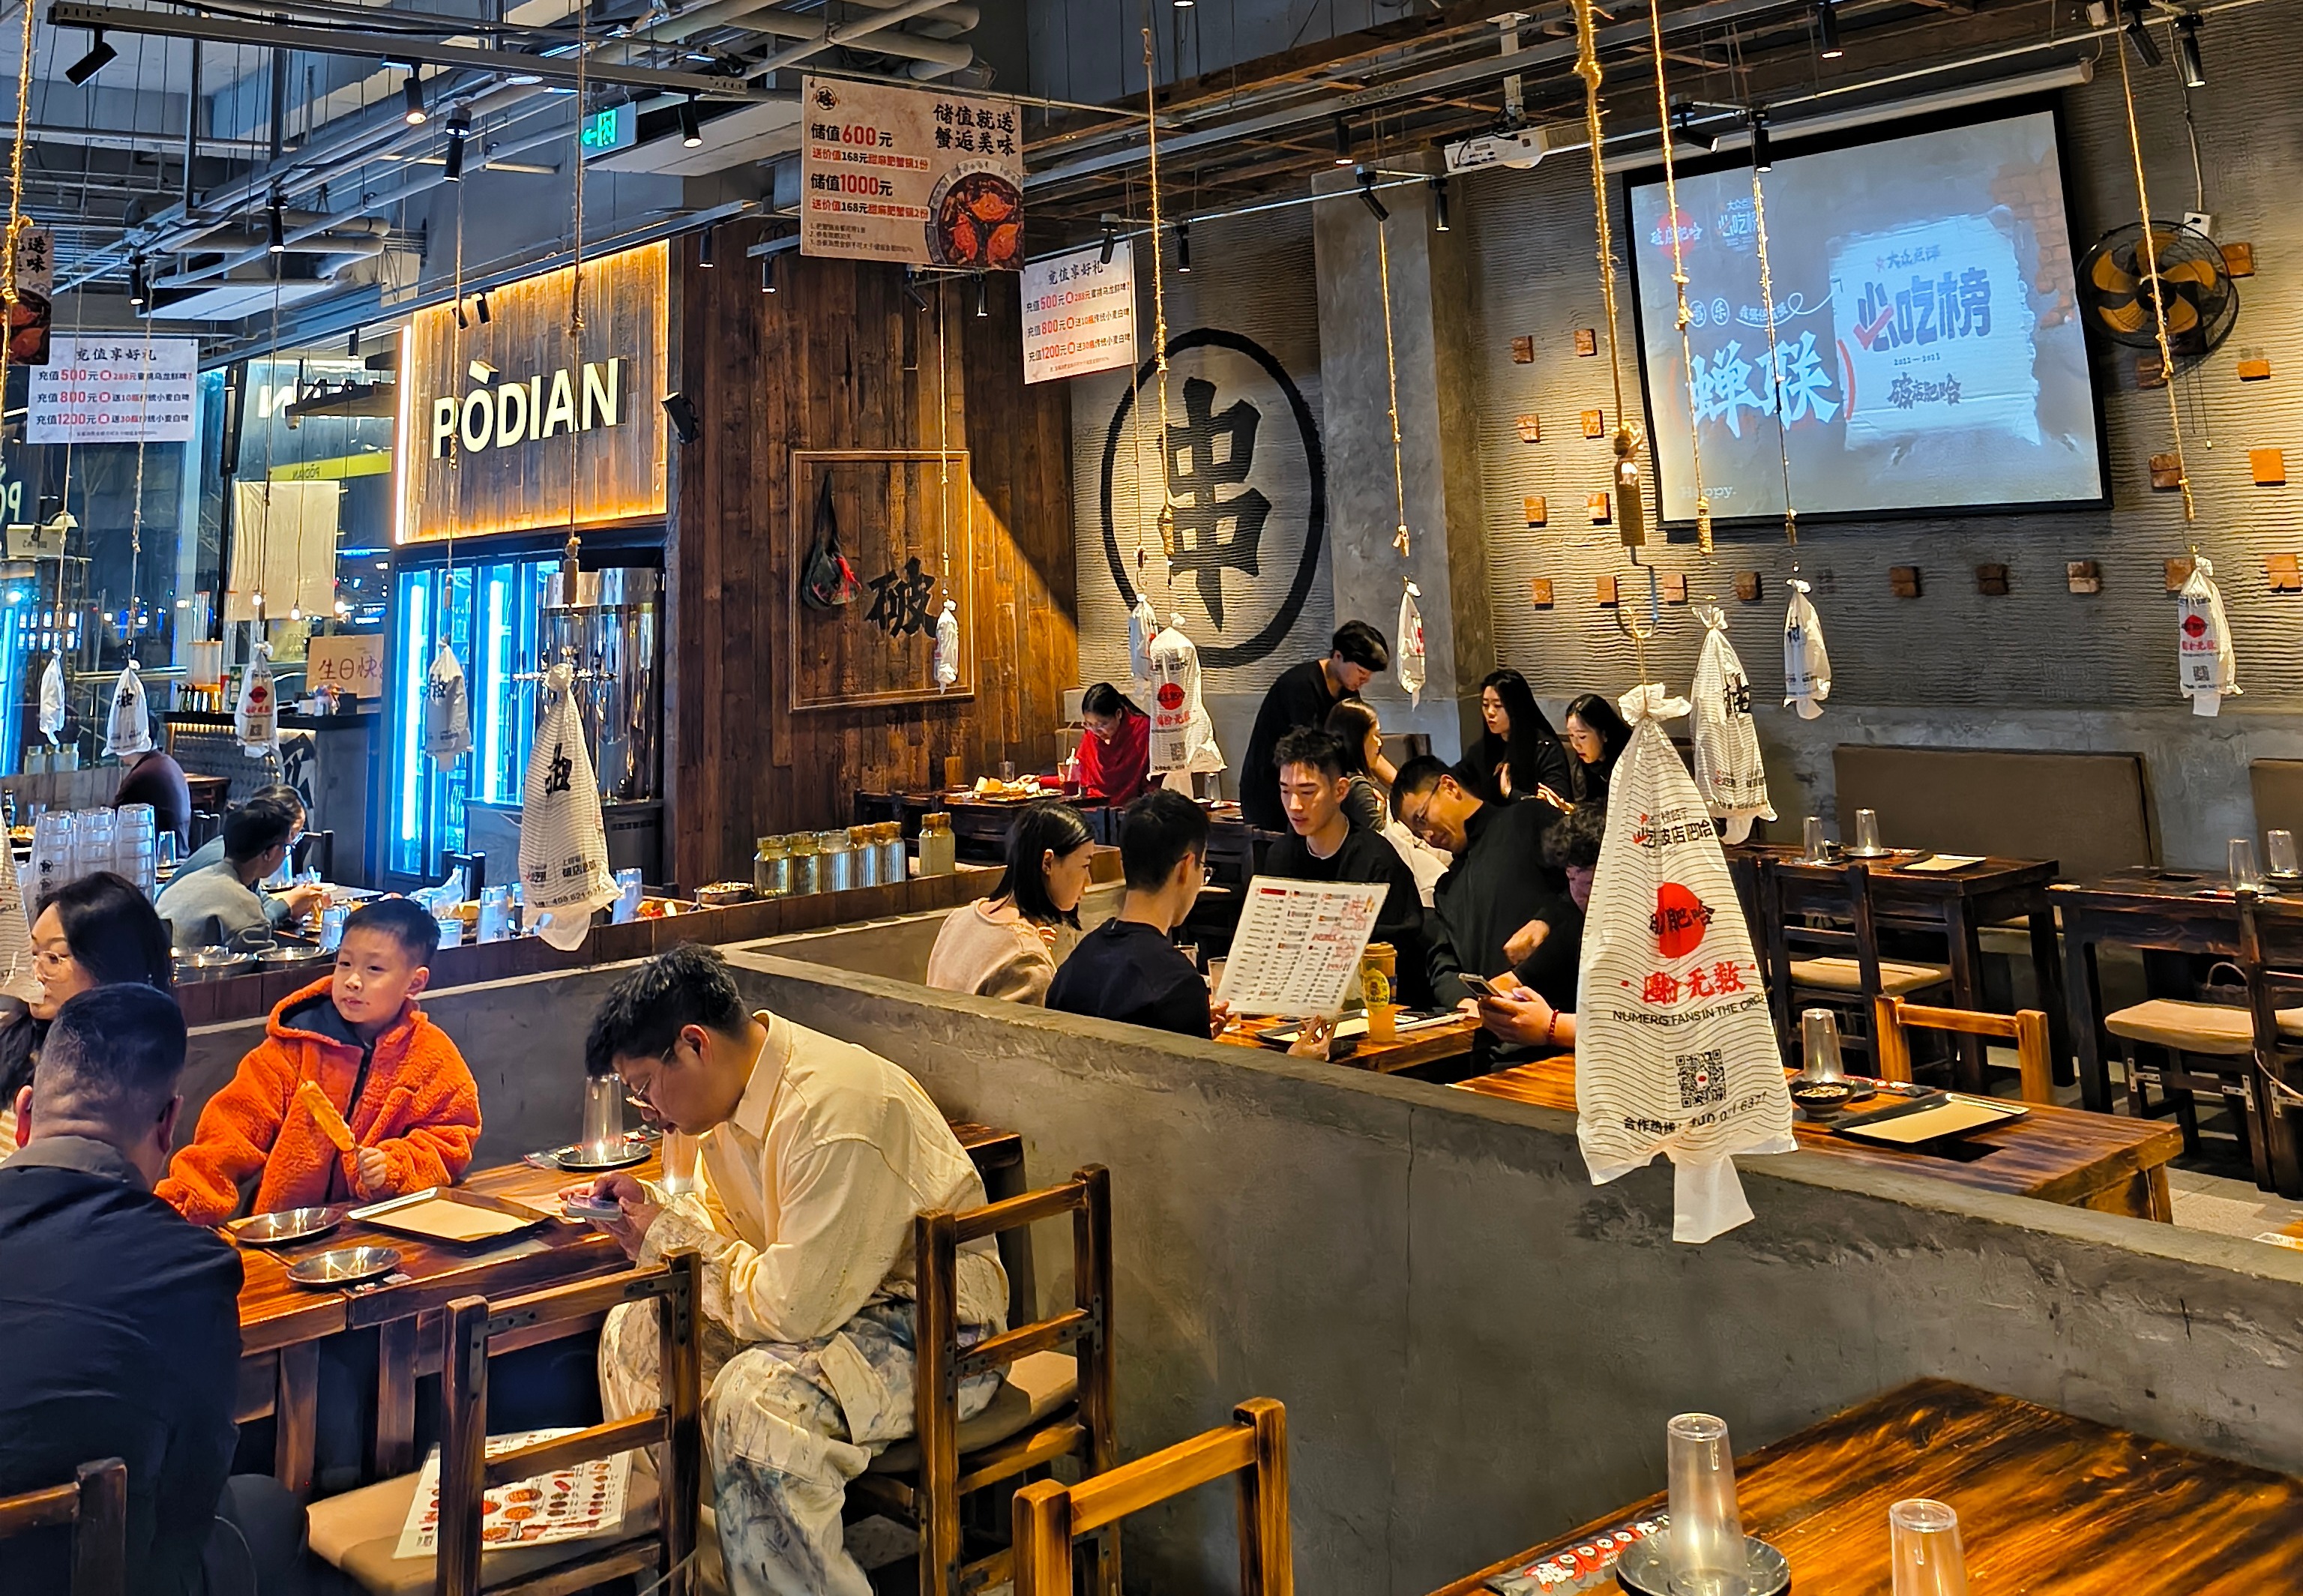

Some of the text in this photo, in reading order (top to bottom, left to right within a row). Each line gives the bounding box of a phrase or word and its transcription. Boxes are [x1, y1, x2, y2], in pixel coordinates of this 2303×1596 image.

[933, 103, 1015, 133] 储值就送
[811, 123, 893, 148] 储值600元
[810, 172, 893, 196] 储值1000元
[1858, 266, 1991, 352] 必吃榜
[1691, 331, 1838, 439] 蝉联
[1157, 376, 1272, 633] 串
[864, 555, 937, 638] 破
[319, 655, 383, 681] 生日快
[1671, 1011, 1701, 1025] FANS
[1701, 1008, 1715, 1020] IN
[1714, 1003, 1738, 1017] THE
